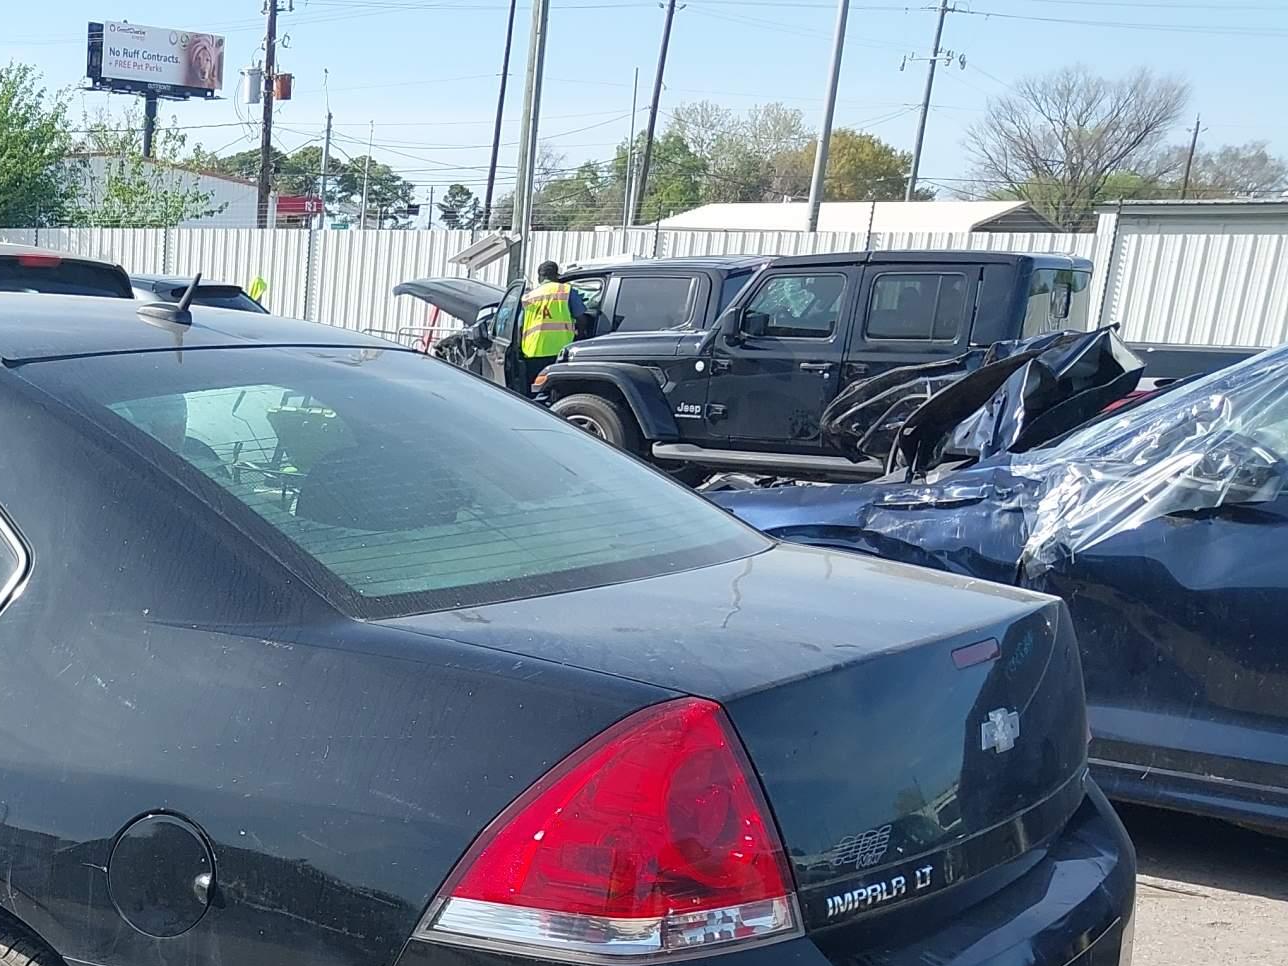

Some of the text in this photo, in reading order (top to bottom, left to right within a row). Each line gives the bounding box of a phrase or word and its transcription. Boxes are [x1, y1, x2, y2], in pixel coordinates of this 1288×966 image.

[109, 48, 181, 64] No Ruff Contracts.
[114, 60, 132, 69] FREE
[677, 402, 701, 414] Jeep
[826, 864, 934, 918] IMPALA LT
